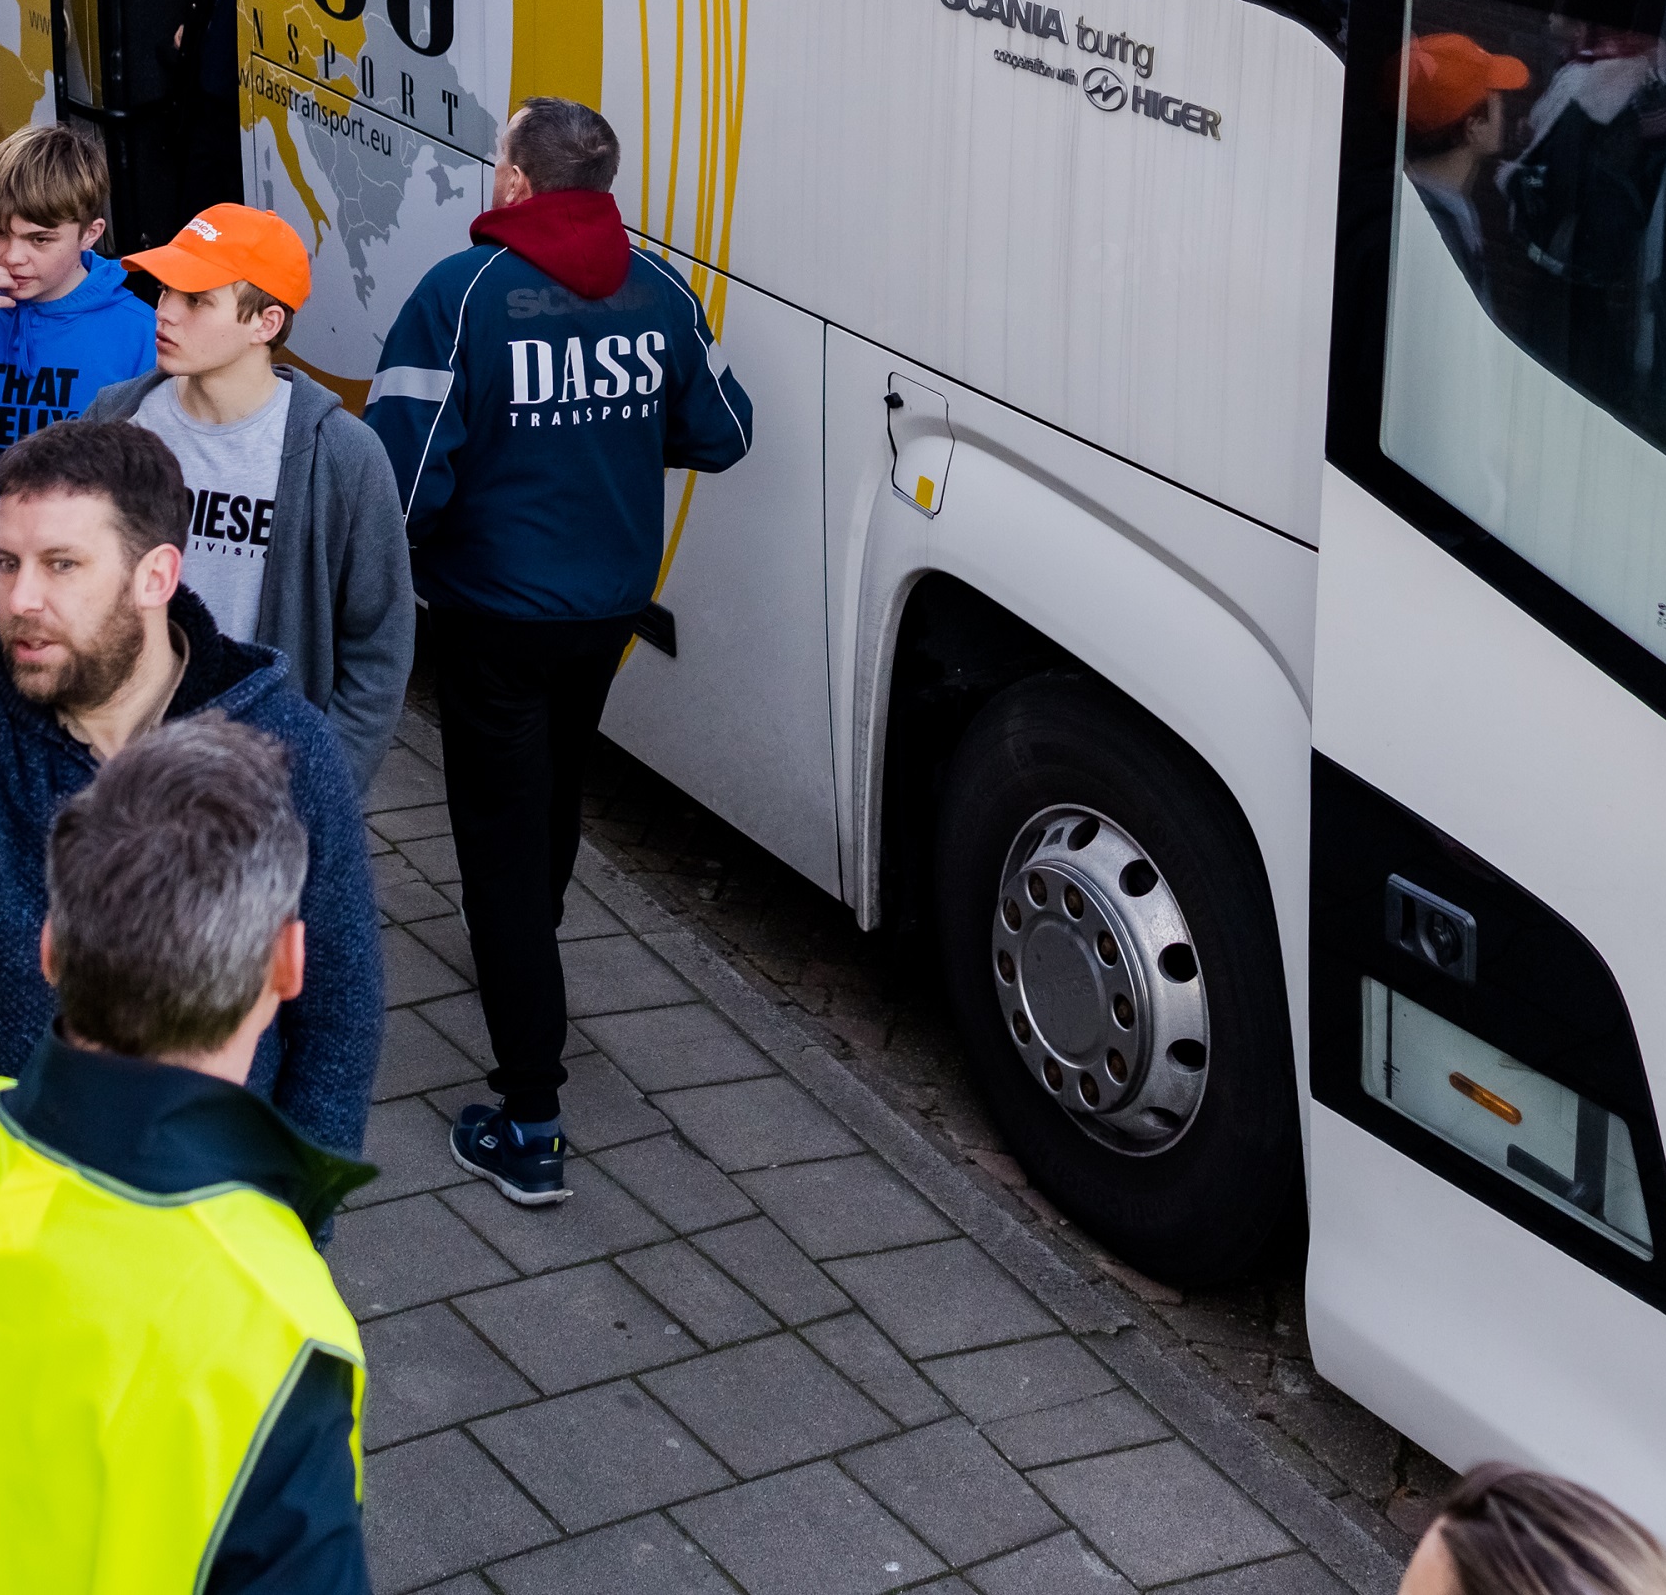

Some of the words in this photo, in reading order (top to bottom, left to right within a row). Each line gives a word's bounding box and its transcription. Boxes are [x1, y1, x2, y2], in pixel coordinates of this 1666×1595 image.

[1075, 15, 1155, 79] touring
[993, 48, 1055, 78] cooperation
[1056, 66, 1078, 86] with
[1131, 84, 1222, 141] HIGER
[507, 330, 666, 404] DASS
[509, 400, 659, 427] TRANSPORT
